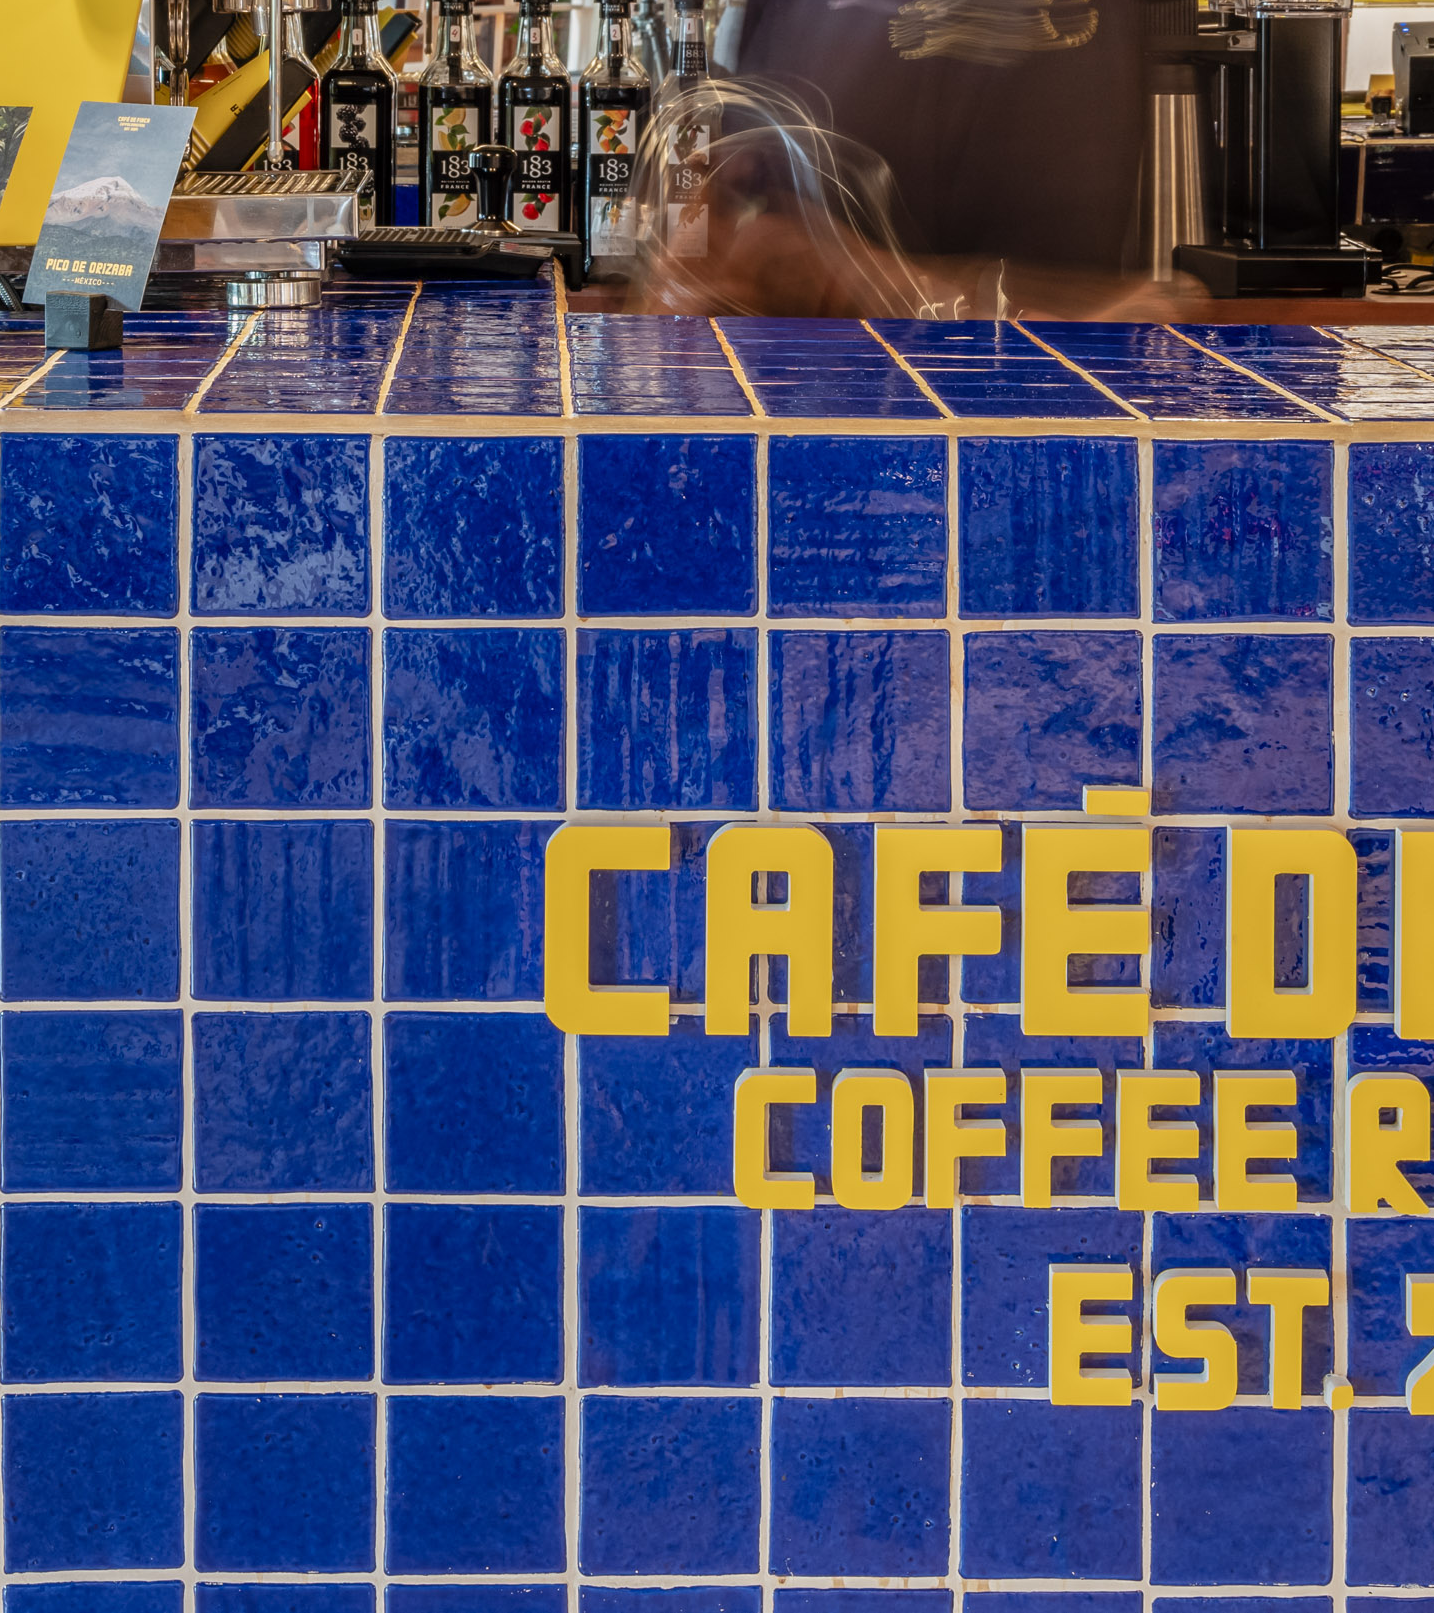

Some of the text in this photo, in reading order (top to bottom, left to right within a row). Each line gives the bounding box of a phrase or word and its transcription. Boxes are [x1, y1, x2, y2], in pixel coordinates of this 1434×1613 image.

[46, 258, 133, 277] PICO DE ORIZABA
[542, 787, 1154, 1040] CAFÉ
[731, 1067, 1299, 1215] COFFEE
[1048, 1264, 1356, 1413] EST.
